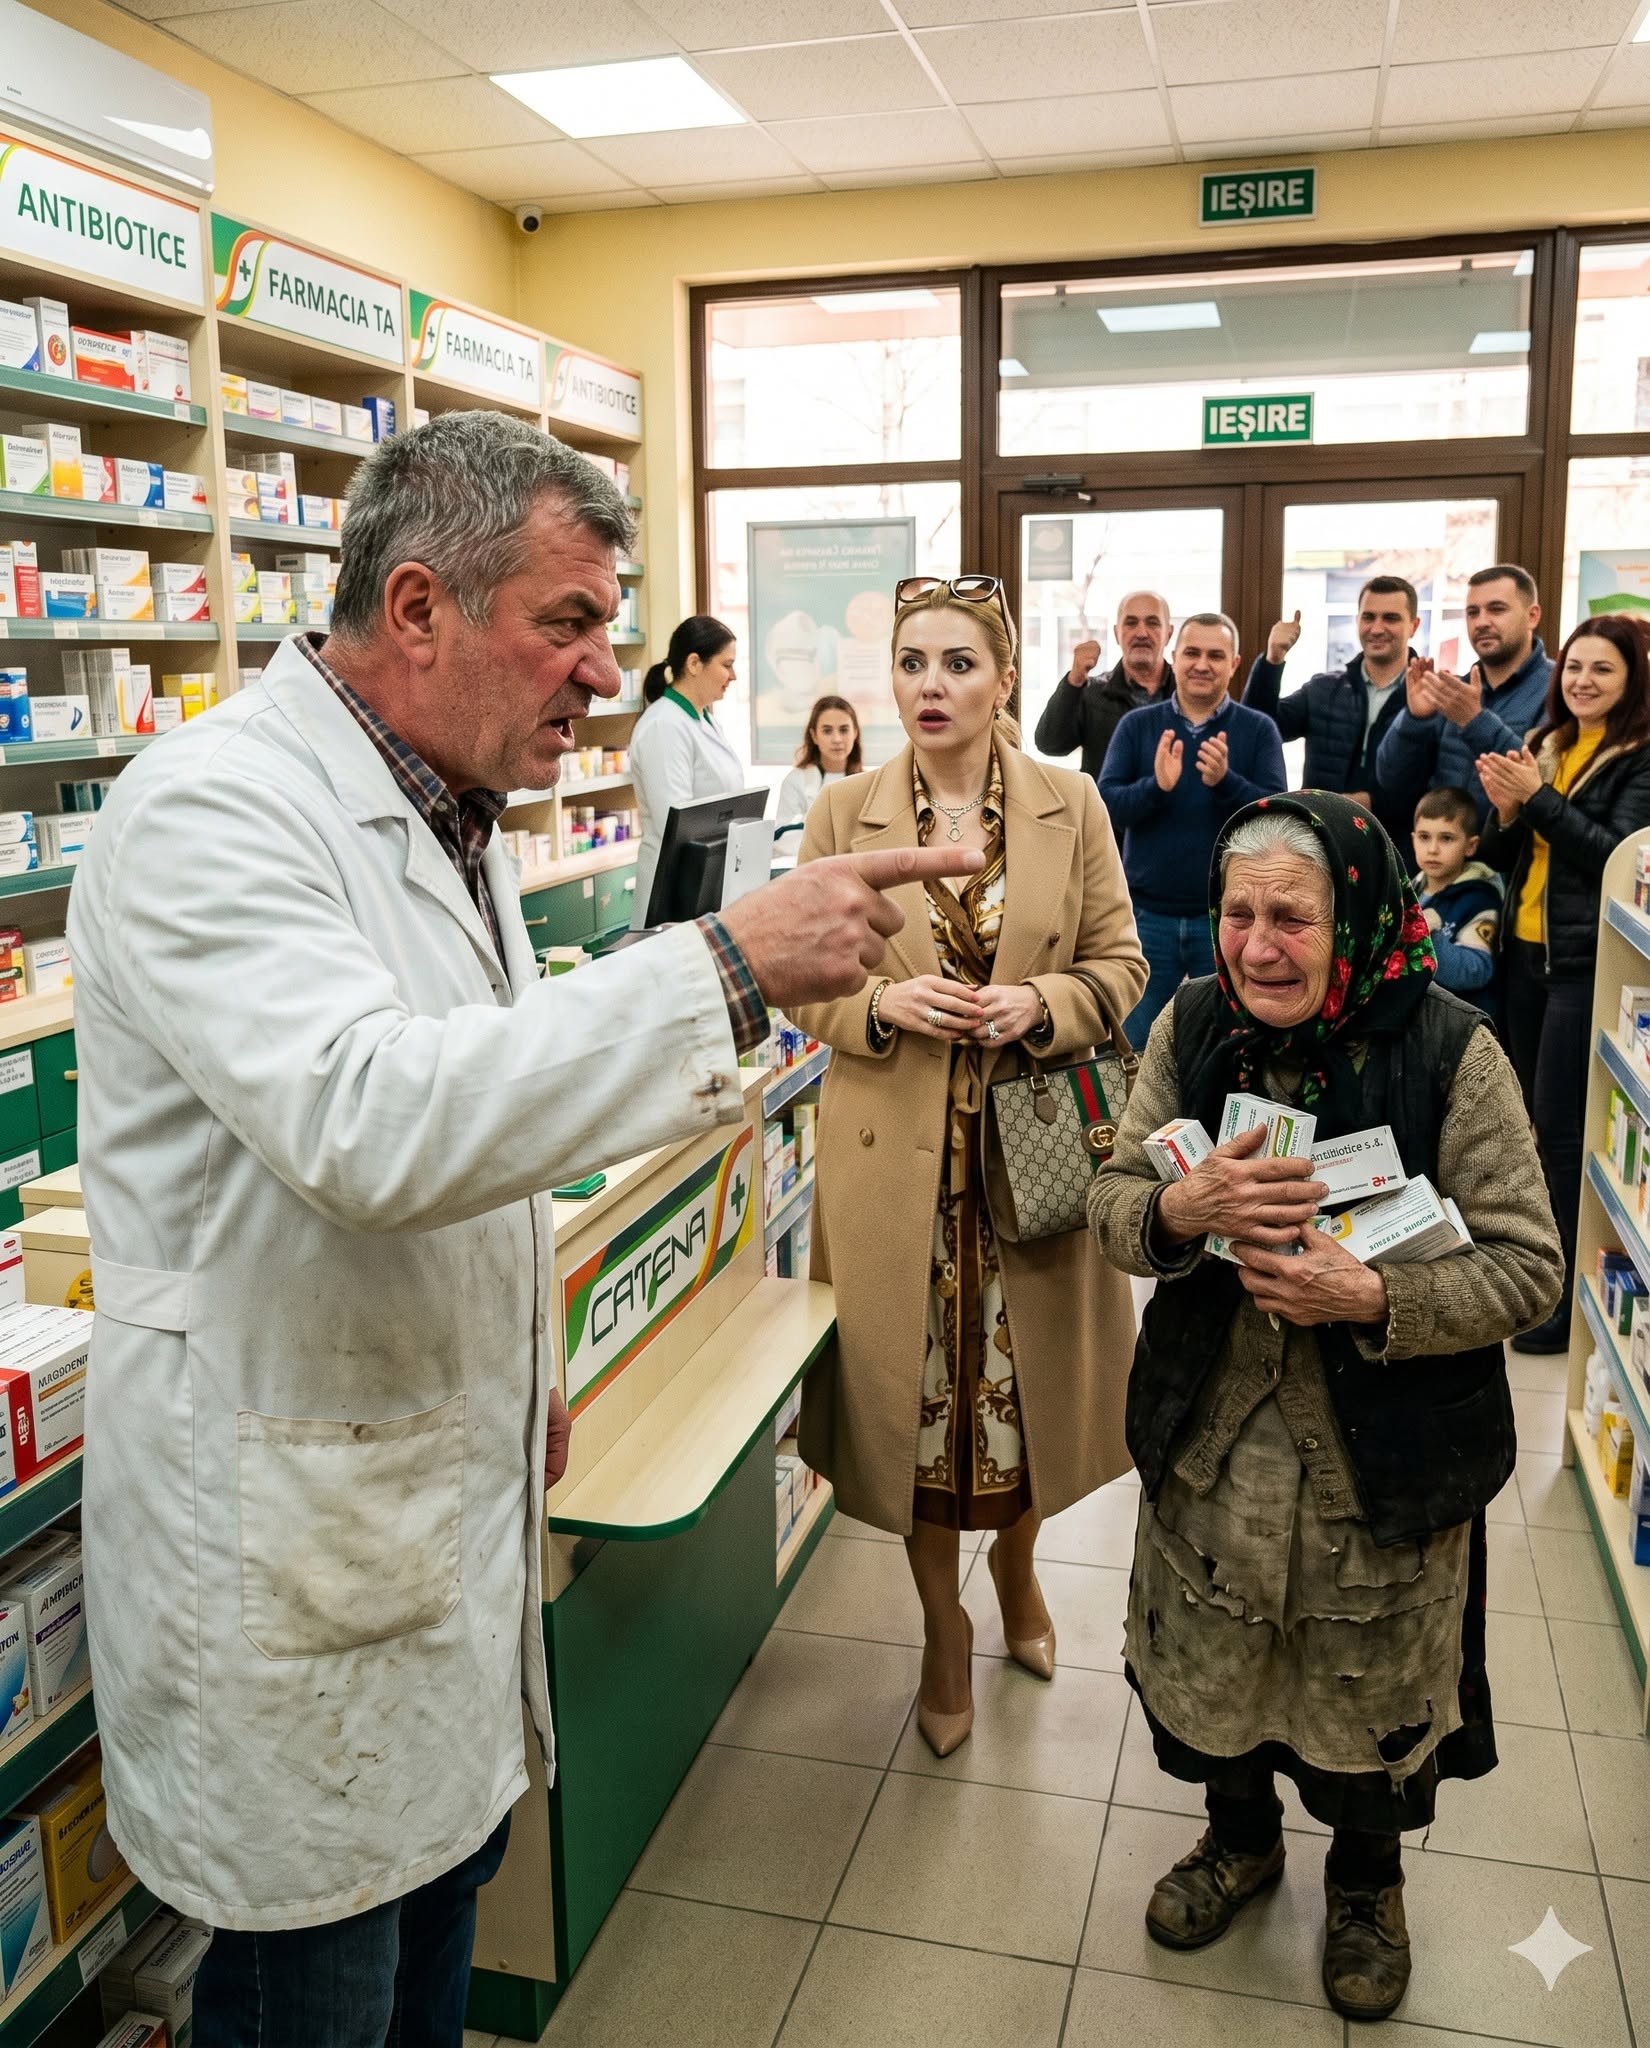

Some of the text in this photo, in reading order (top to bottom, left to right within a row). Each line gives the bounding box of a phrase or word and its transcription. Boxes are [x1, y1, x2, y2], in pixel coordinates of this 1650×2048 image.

[1210, 178, 1305, 216] IEȘIRE
[17, 183, 187, 269] ANTIBIOTICE
[268, 267, 395, 337] FARMACIA TA
[445, 330, 535, 382] FARMACIA TA
[571, 376, 637, 416] ANTIBIOTICE
[1209, 403, 1306, 441] IEȘIRE
[591, 1206, 705, 1347] CATENA
